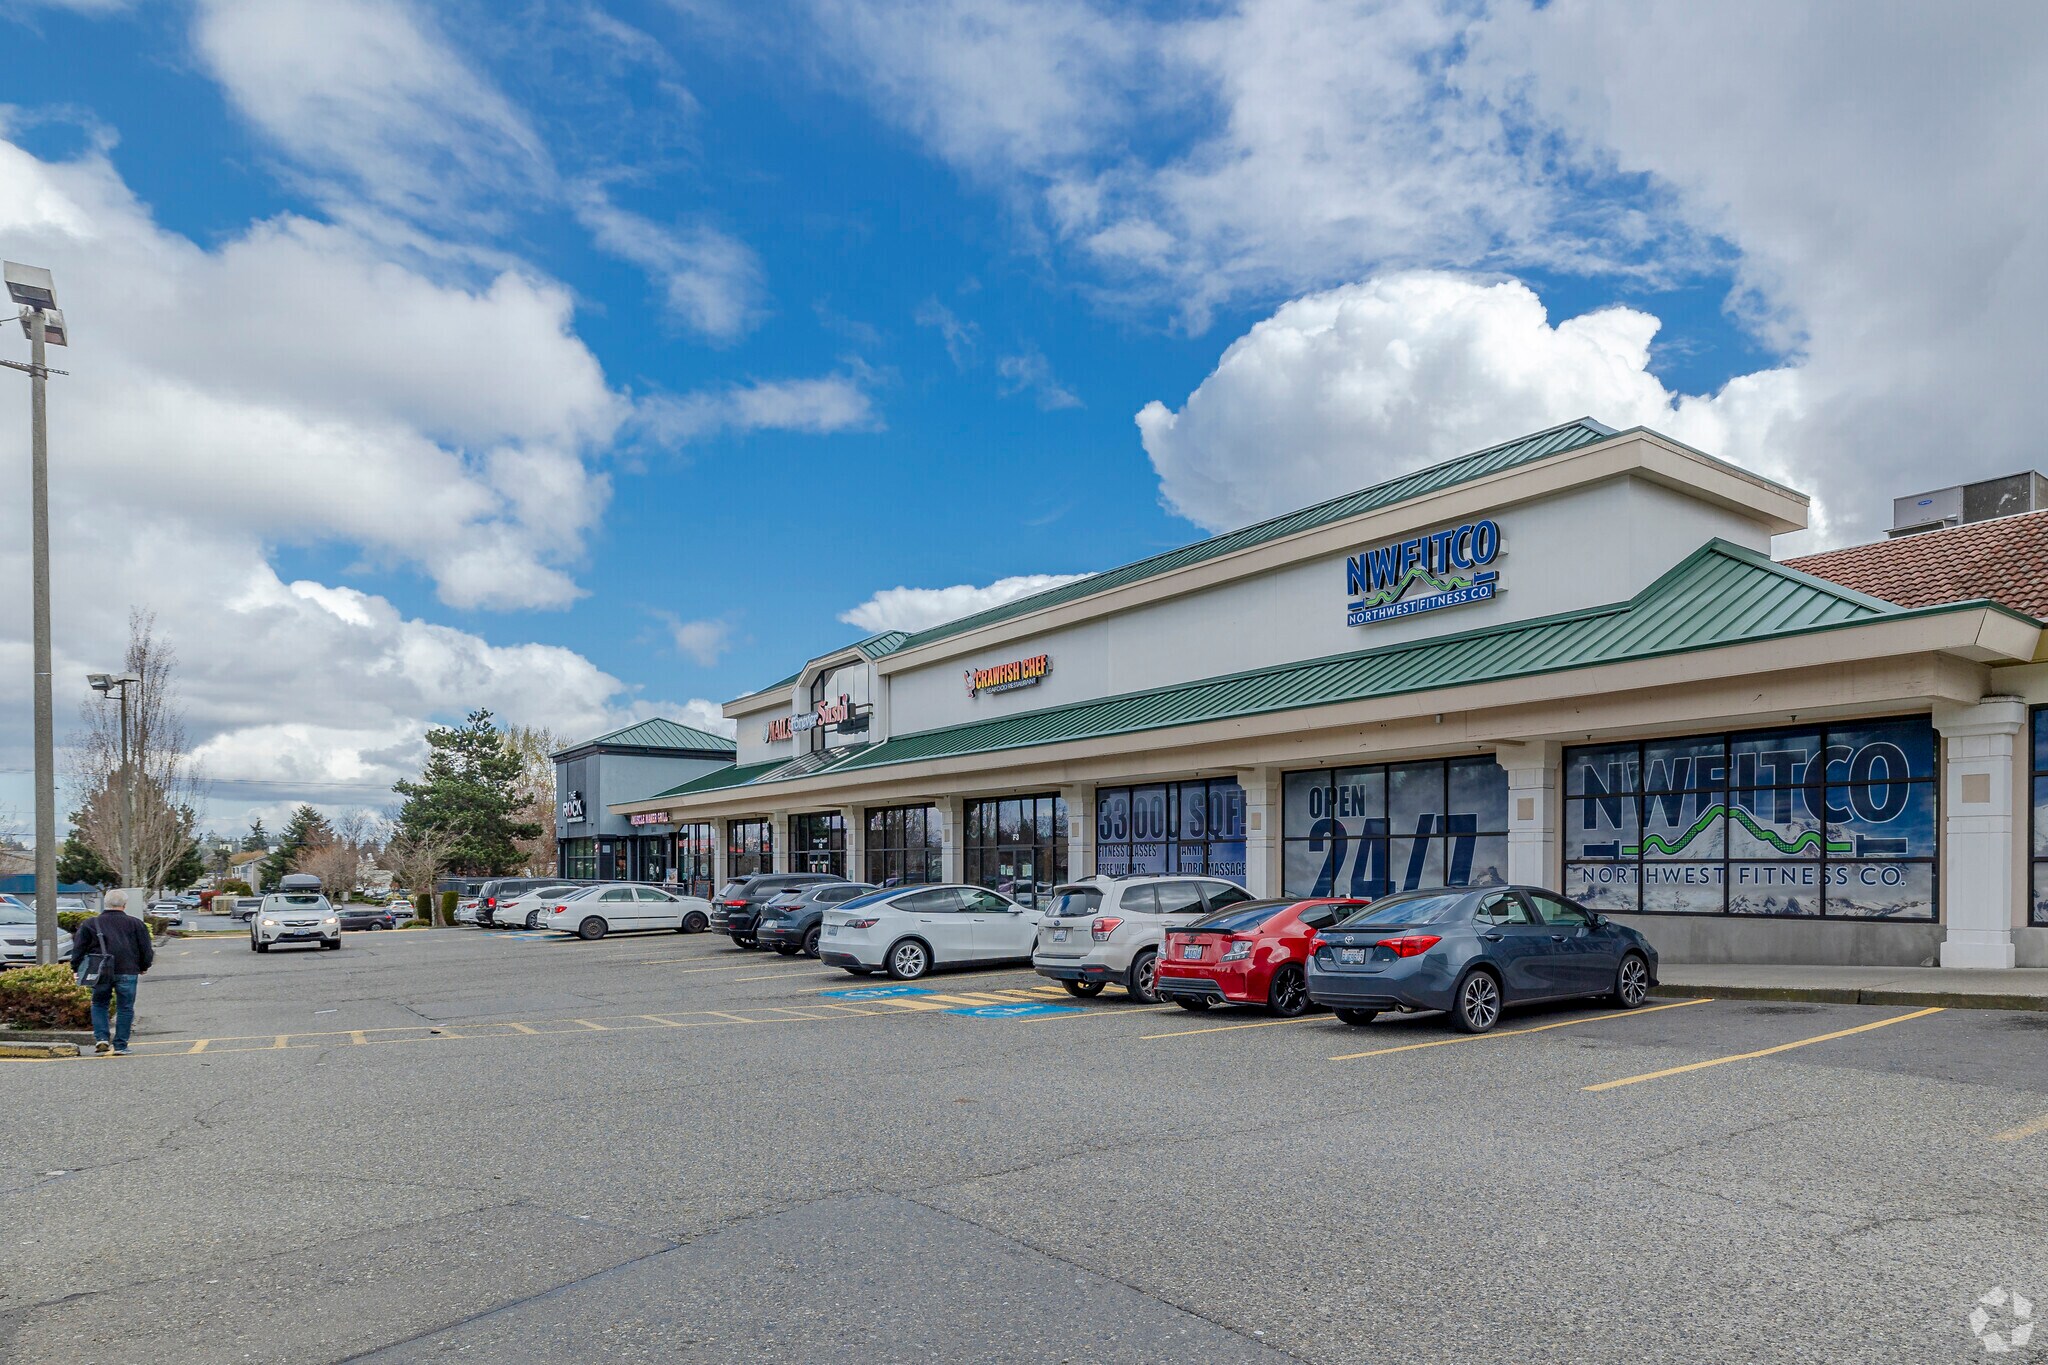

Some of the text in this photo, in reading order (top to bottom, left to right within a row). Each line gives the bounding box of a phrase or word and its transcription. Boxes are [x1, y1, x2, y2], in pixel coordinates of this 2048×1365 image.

[1346, 519, 1498, 595] NWFITCO
[1348, 586, 1491, 625] NORTHWEST FITNESS CO.
[975, 654, 1047, 690] CRAWFISH CHEF
[986, 677, 1037, 694] SEAFOOD RESTAURANT
[817, 693, 848, 726] Sushi
[1581, 741, 1911, 831] NWFITCO
[562, 800, 583, 817] ROCK
[1308, 784, 1366, 819] OPEN
[631, 814, 645, 825] MUSCLE
[657, 811, 668, 823] GRILL
[1098, 844, 1125, 858] FITNESS
[1308, 812, 1478, 900] 24/7
[1098, 861, 1146, 875] FREE WEIHTS
[1208, 861, 1246, 876] MASSAGE
[1581, 866, 1907, 887] NORTHWEST FITNESS CO.
